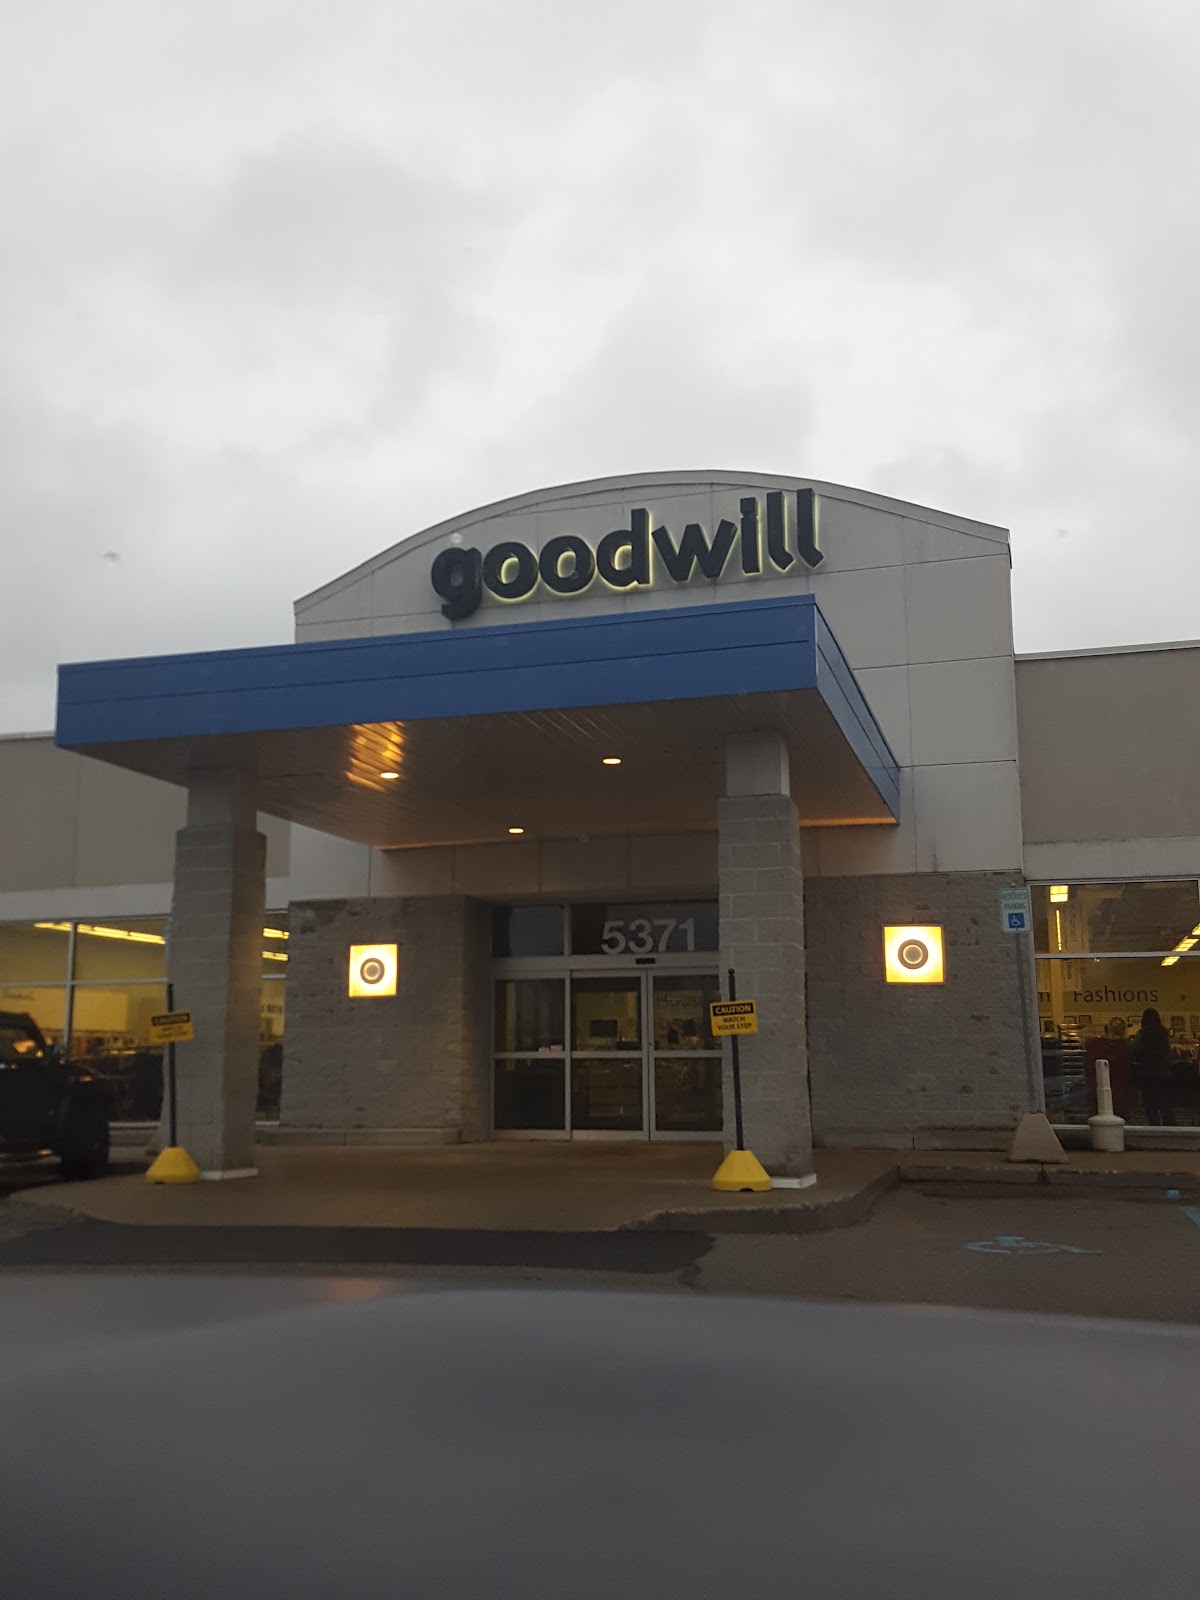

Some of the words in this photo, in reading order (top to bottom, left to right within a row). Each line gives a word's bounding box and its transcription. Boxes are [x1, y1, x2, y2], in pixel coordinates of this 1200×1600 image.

[431, 487, 824, 619] goodwill
[601, 917, 695, 954] 5371
[715, 1004, 752, 1015] CAUTION
